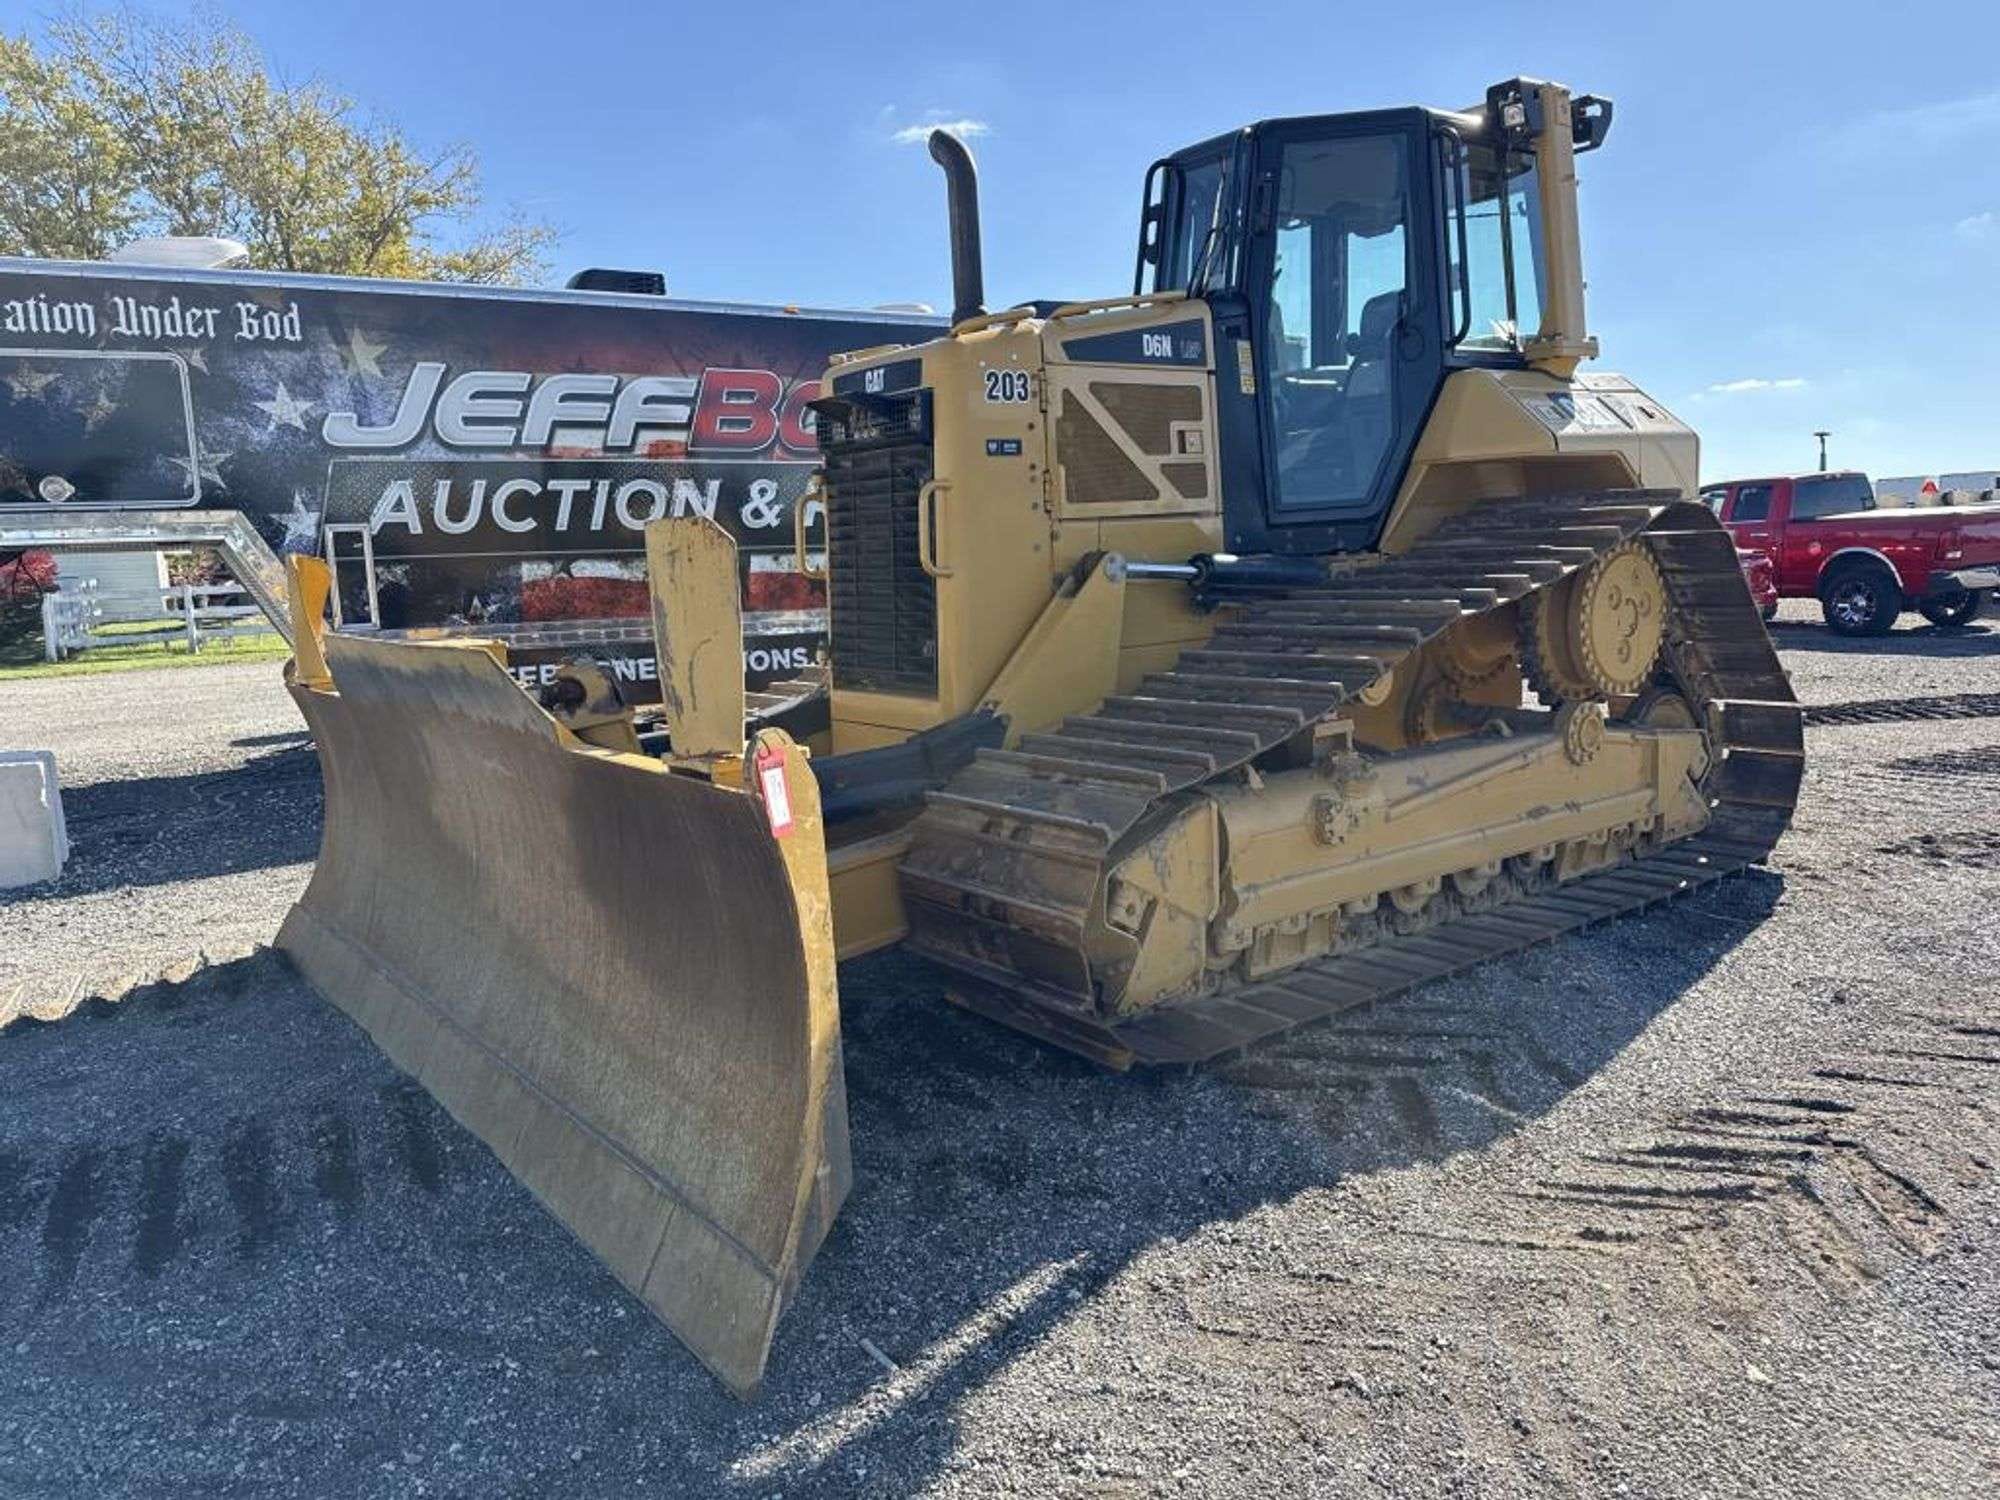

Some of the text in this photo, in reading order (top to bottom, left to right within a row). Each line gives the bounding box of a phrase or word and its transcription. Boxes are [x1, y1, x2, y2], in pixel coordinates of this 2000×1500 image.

[0, 293, 302, 342] ation Under God
[1142, 333, 1173, 358] D6N
[865, 367, 885, 393] CAT
[985, 369, 1031, 404] 203
[370, 479, 722, 535] AUCTION
[741, 478, 784, 529] &
